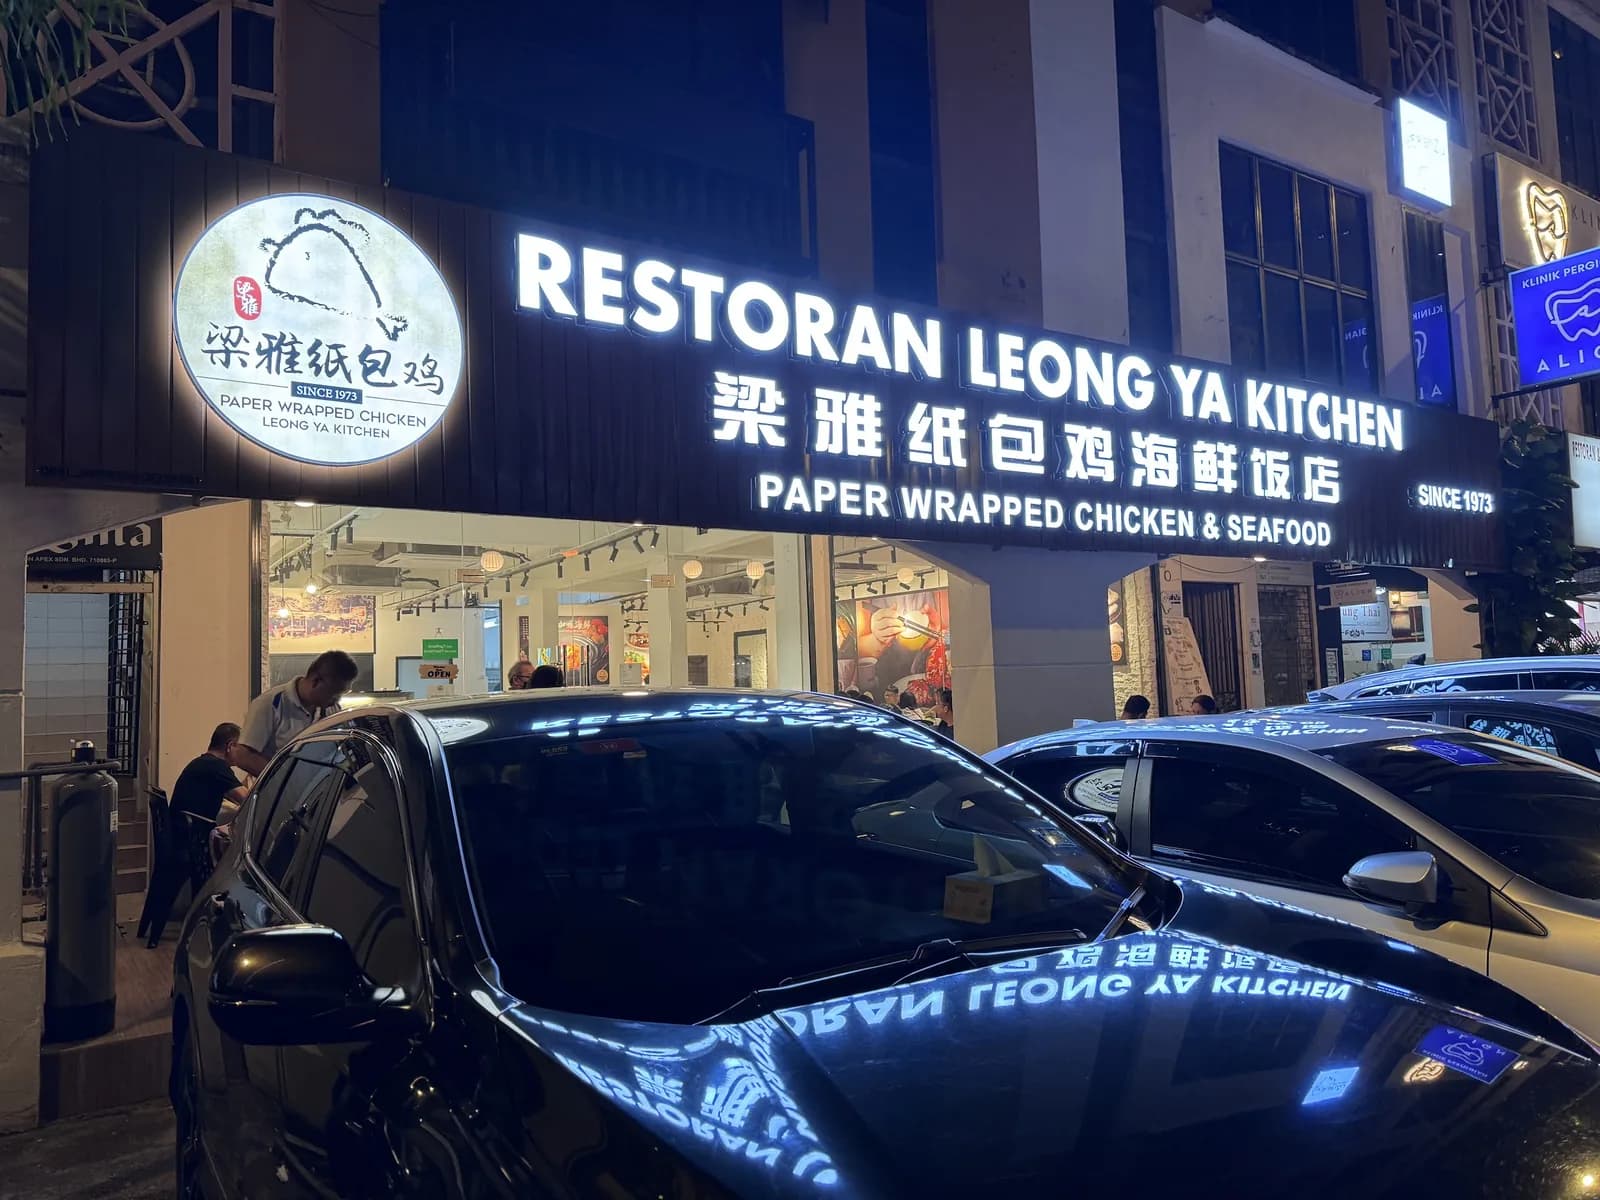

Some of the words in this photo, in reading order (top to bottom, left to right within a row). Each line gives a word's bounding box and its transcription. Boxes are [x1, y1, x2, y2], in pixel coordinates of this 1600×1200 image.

[1521, 271, 1560, 289] KLINIK
[1563, 259, 1600, 277] PERGI
[518, 233, 942, 379] RESTORAN
[969, 327, 1155, 411] LEONG
[1170, 364, 1232, 423] YA
[1246, 379, 1403, 451] KITCHEN
[201, 322, 445, 396] 梁雅纸包鸡
[296, 385, 332, 399] SINCE
[334, 388, 358, 401] 1973
[220, 394, 272, 411] PAPER
[279, 400, 354, 420] WRAPPED
[360, 410, 426, 427] CHICKEN
[262, 416, 309, 430] LEONG
[314, 422, 330, 433] YA
[334, 424, 390, 438] KITCHEN
[713, 371, 1340, 504] 梁雅纸包鸡海鲜饭店
[759, 473, 890, 518] PAPER
[901, 486, 1064, 529] WRAPPED
[1074, 501, 1195, 538] CHICKEN
[1203, 512, 1221, 540] &
[1227, 514, 1331, 547] SEAFOOD
[1418, 484, 1462, 510] SINCE
[1463, 490, 1494, 513] 1973
[428, 670, 451, 678] OPEN
